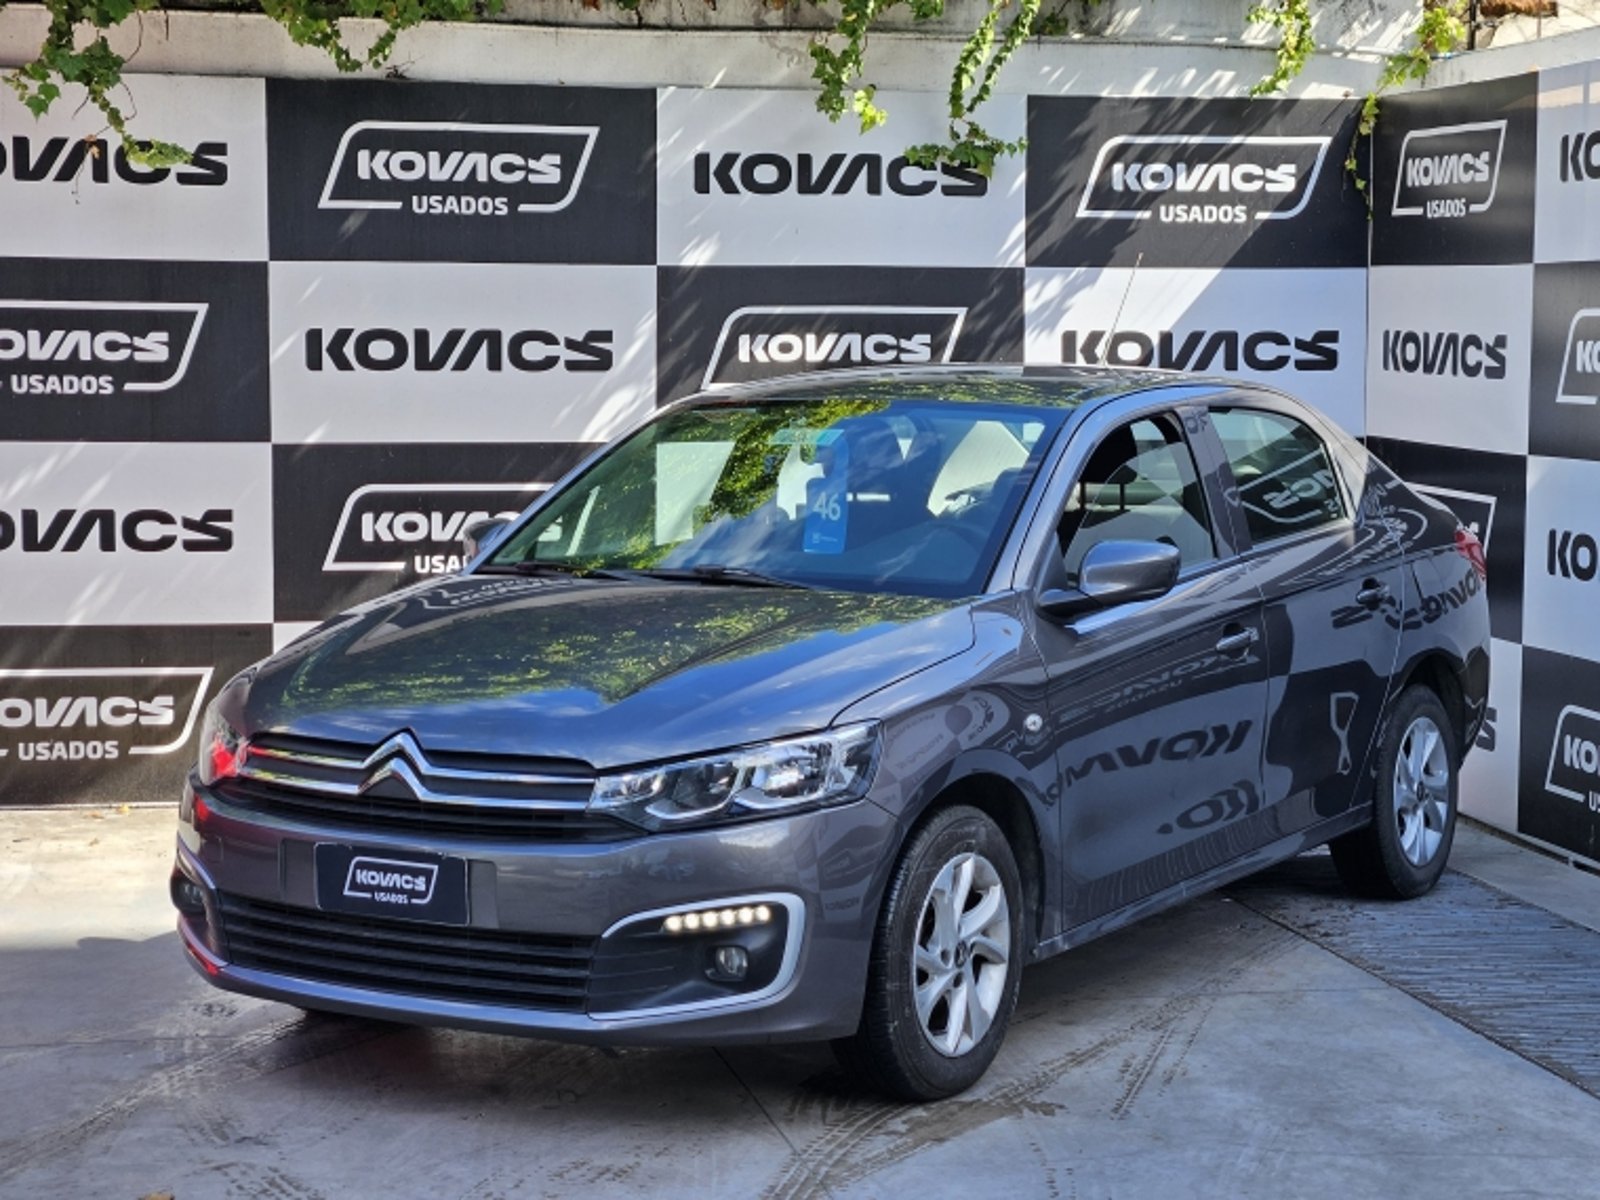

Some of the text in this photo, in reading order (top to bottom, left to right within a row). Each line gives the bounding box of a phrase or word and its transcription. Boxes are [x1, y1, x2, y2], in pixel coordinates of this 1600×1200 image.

[0, 136, 228, 186] VACS
[357, 149, 561, 184] KOVACS
[694, 152, 988, 197] KOVACS
[1111, 162, 1297, 193] KOVACS
[1407, 151, 1490, 187] KOVACS
[412, 195, 509, 216] USADOS
[1159, 204, 1247, 224] USADOS
[1426, 198, 1467, 219] USADOS
[305, 328, 614, 372] KOVACS
[738, 332, 932, 363] KOVACS
[1062, 330, 1340, 371] KOVACS
[1383, 329, 1507, 380] KOVACS
[10, 374, 114, 395] USADOS
[812, 492, 841, 521] 46
[0, 508, 233, 553] VACS
[18, 740, 119, 761] USADOS
[1563, 734, 1600, 775] KO
[355, 868, 427, 892] KOVACS
